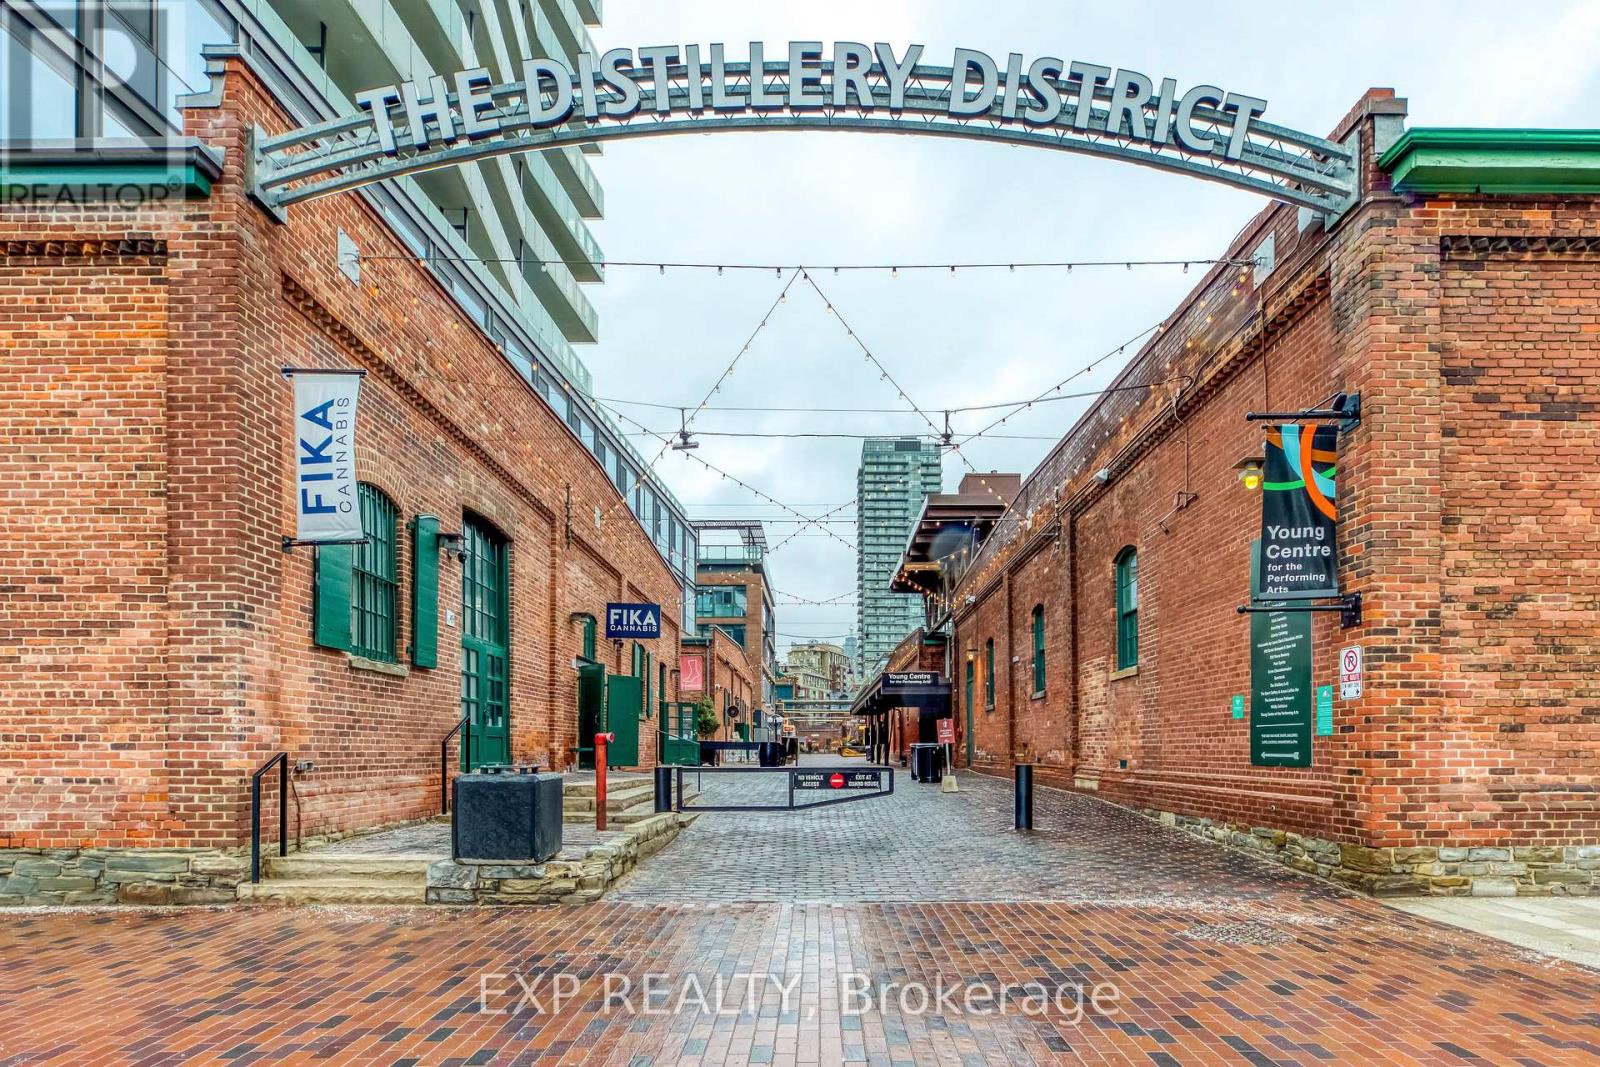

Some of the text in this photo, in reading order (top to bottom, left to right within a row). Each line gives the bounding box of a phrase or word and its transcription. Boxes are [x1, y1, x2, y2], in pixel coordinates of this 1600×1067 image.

[355, 41, 1267, 162] THE DISTILLERY DISTRICT
[300, 399, 337, 515] FIKA
[336, 397, 352, 513] CANNABIS
[1267, 525, 1325, 540] Young
[1266, 544, 1331, 559] Centre
[1267, 562, 1303, 572] for the
[1267, 573, 1326, 583] Performing
[1267, 586, 1289, 594] Arts
[610, 608, 657, 626] FIKA
[610, 625, 658, 633] CANNABIS
[888, 673, 908, 681] Young
